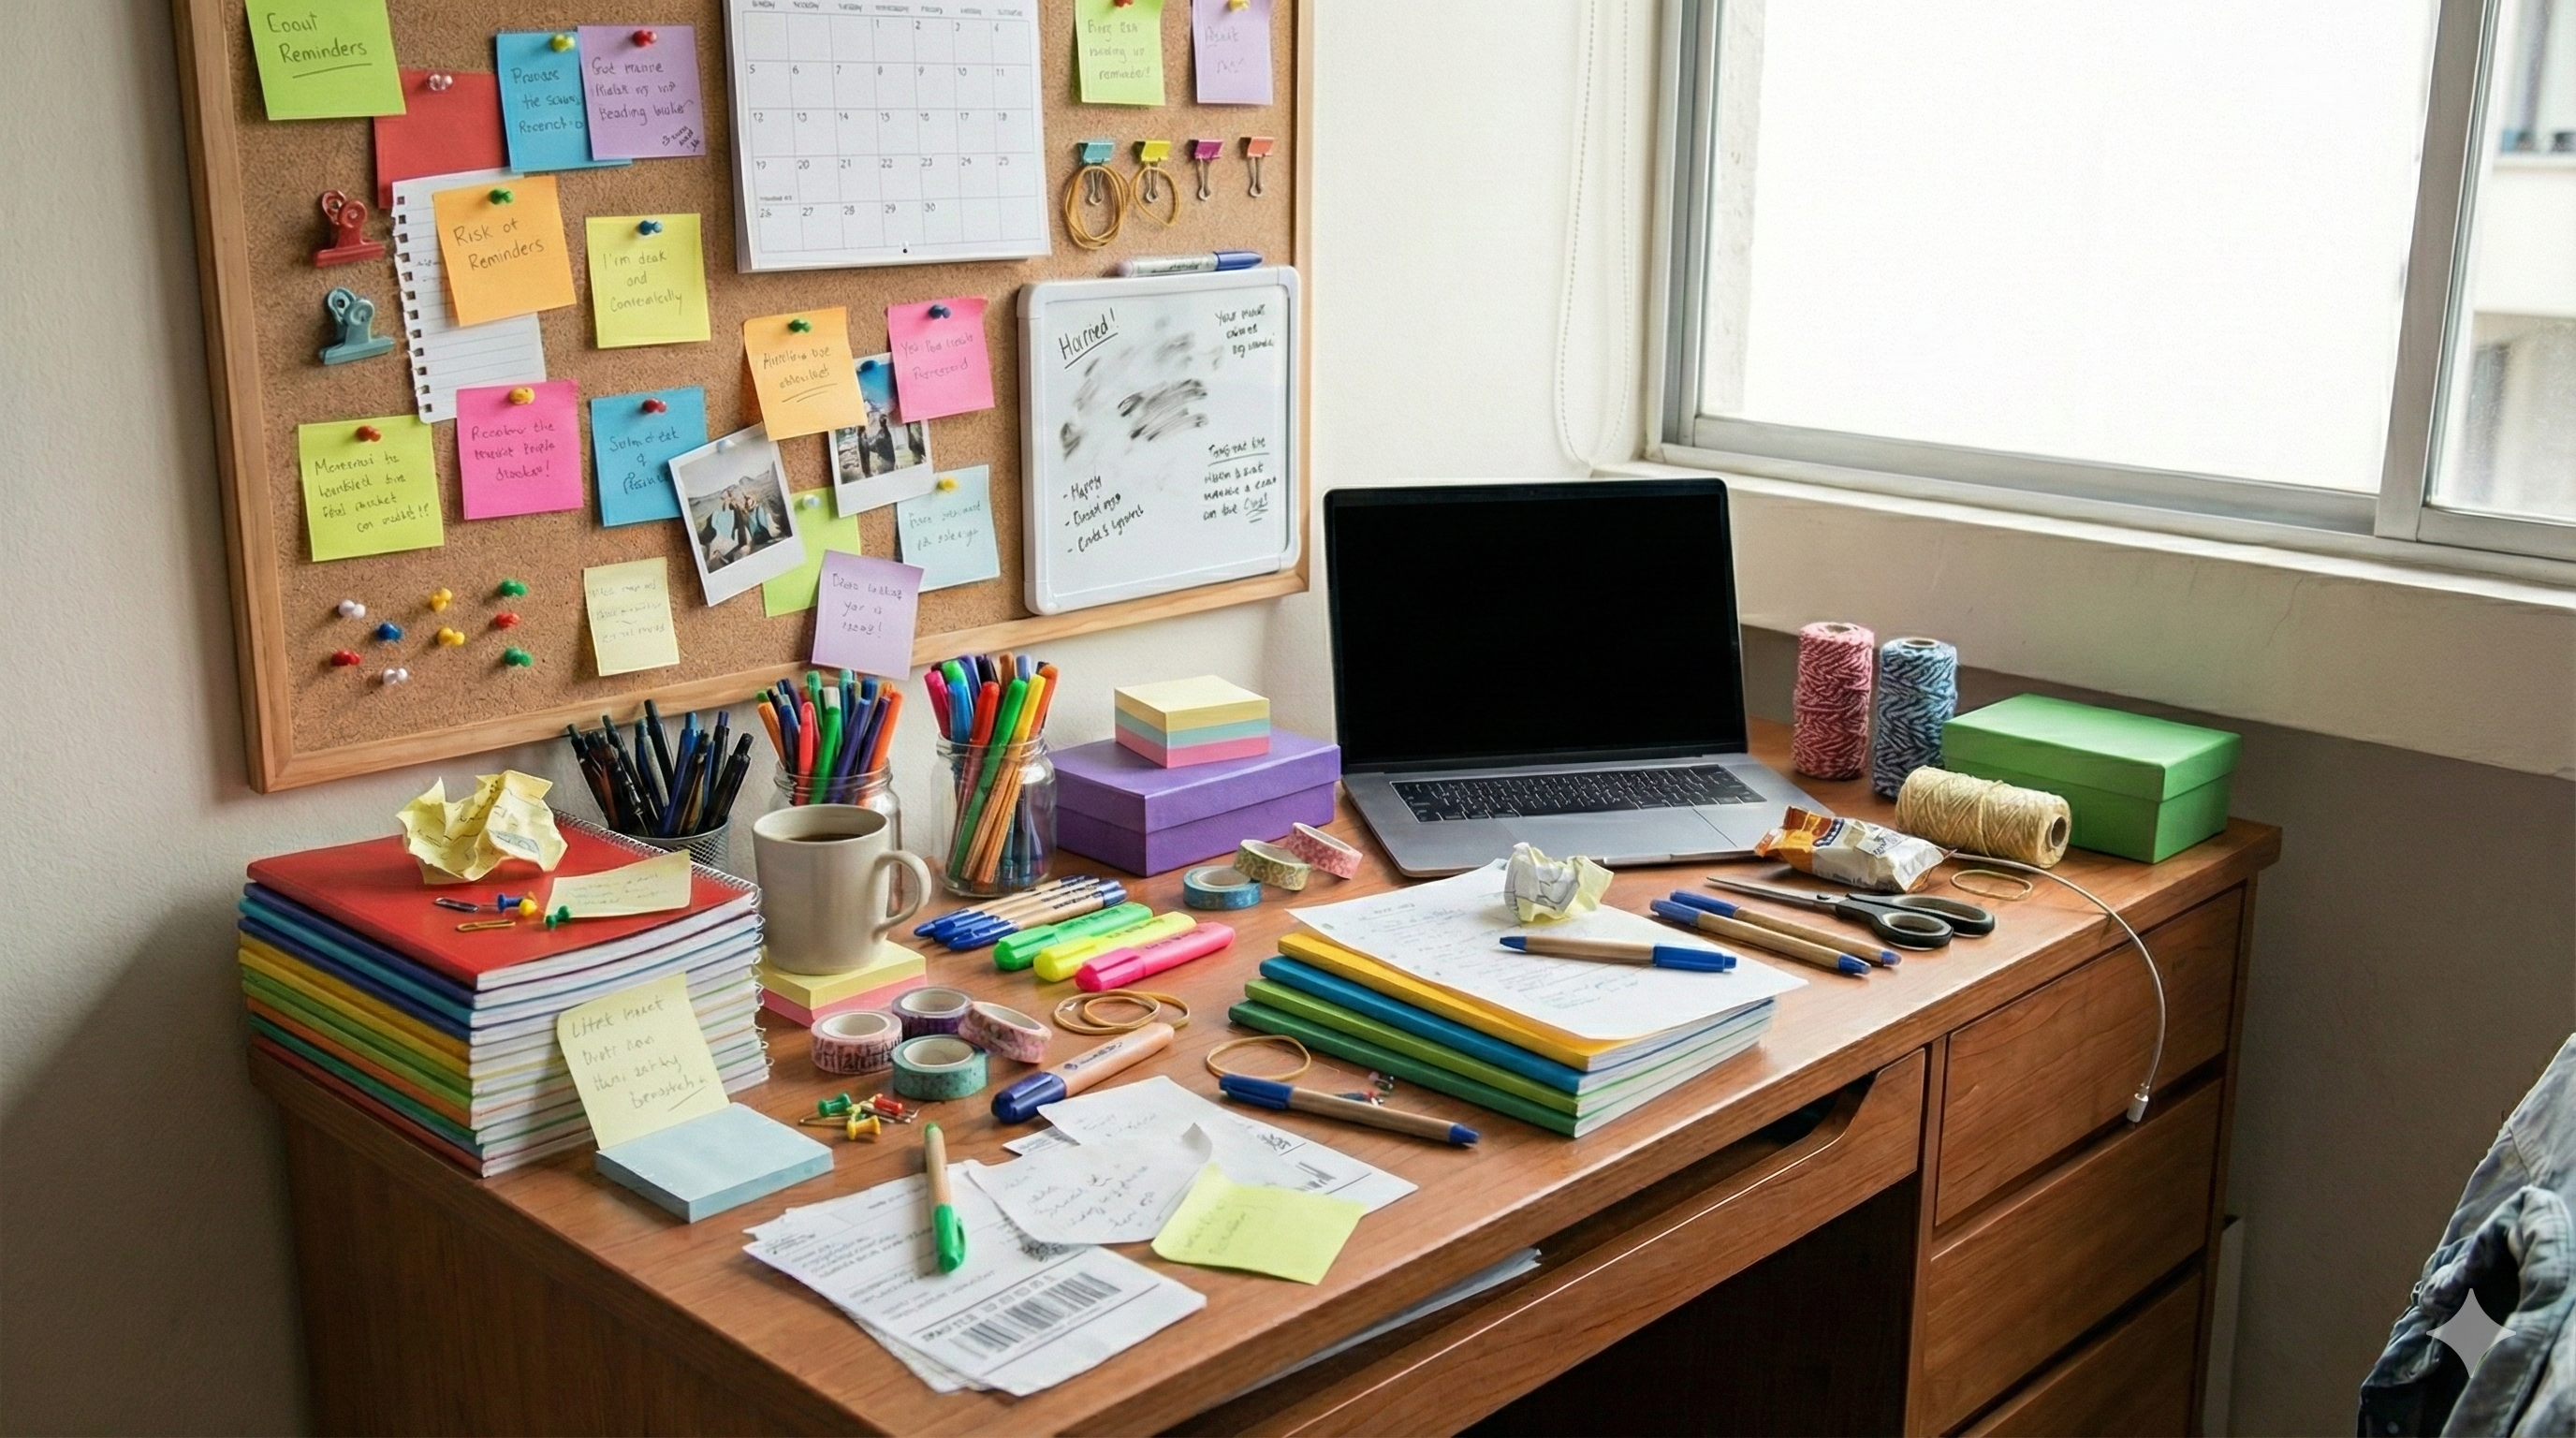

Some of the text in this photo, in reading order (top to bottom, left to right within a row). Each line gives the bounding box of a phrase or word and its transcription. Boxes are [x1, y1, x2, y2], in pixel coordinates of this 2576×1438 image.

[915, 21, 921, 30] 2
[278, 37, 368, 64] Reminders
[792, 65, 799, 75] 6
[836, 65, 842, 75] 7
[996, 67, 1004, 76] 11
[839, 112, 849, 121] 14
[959, 112, 969, 121] 17
[798, 159, 810, 169] 20
[841, 158, 851, 169] 21
[802, 207, 813, 216] 27
[843, 205, 855, 215] 28
[885, 203, 896, 213] 29
[925, 202, 936, 213] 30
[453, 225, 494, 246] Risk
[468, 239, 545, 271] Reminders
